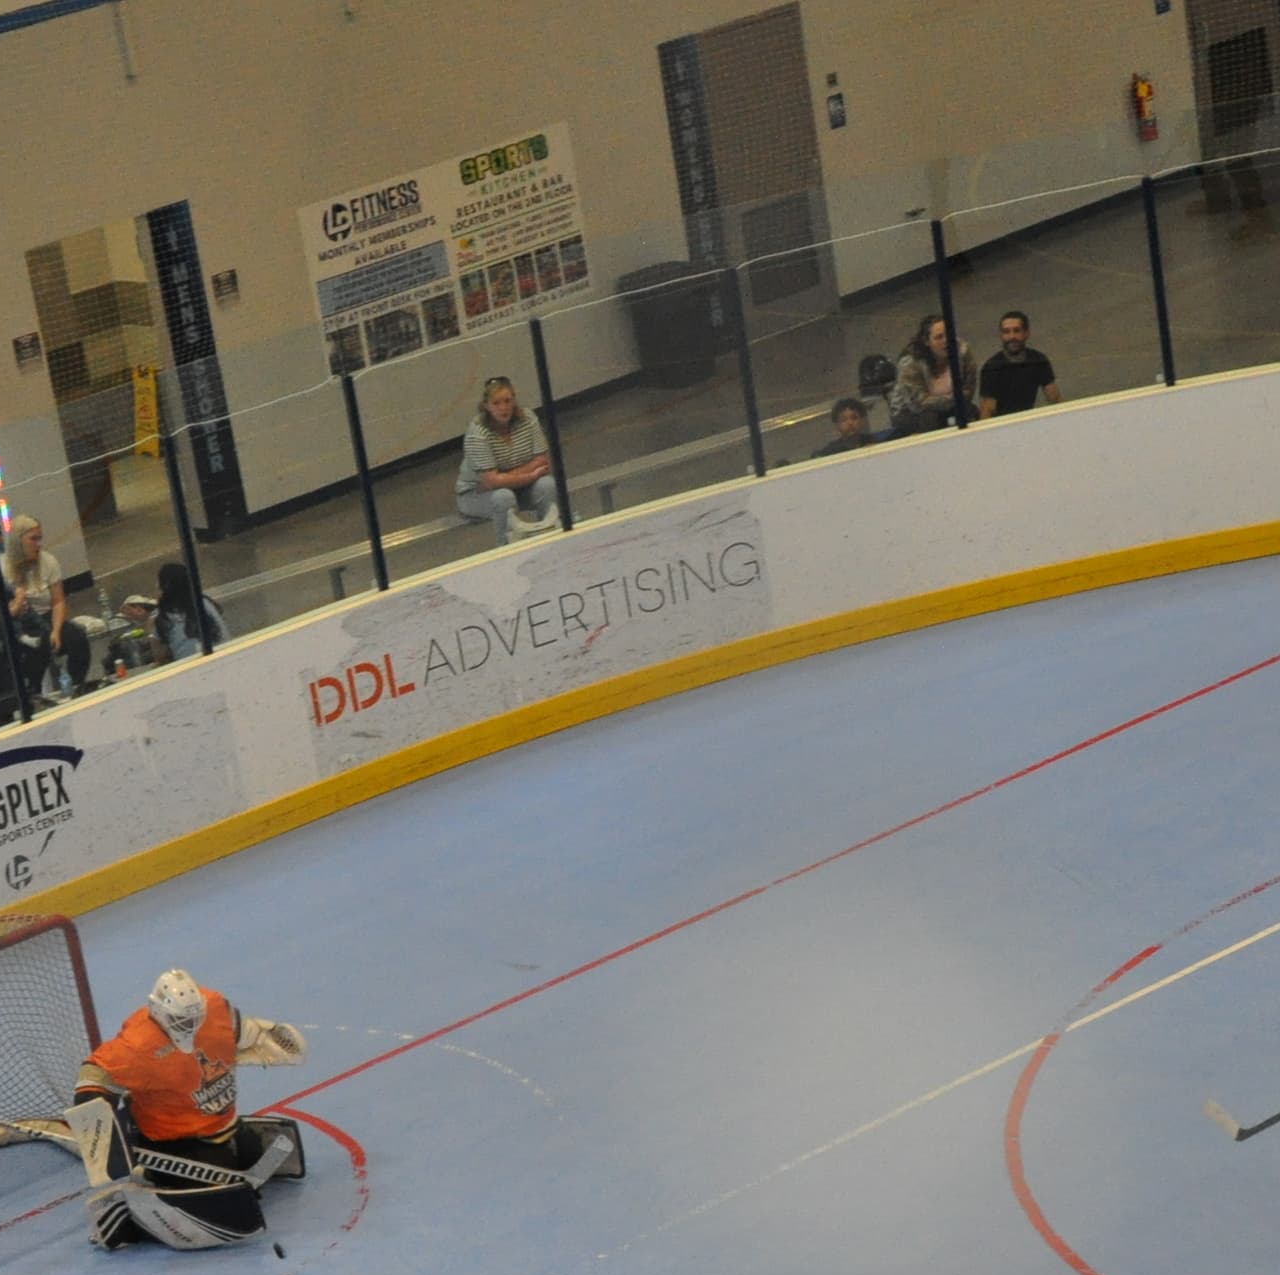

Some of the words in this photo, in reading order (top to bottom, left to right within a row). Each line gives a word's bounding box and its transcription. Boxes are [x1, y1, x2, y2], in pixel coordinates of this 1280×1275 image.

[459, 134, 549, 185] SPORTS
[350, 179, 420, 224] FITNESS
[456, 186, 527, 218] RESTAURANT
[318, 239, 367, 261] MONTHLY
[309, 653, 415, 727] DDL
[424, 541, 761, 687] ADVERTISING
[35, 809, 74, 836] CENTER
